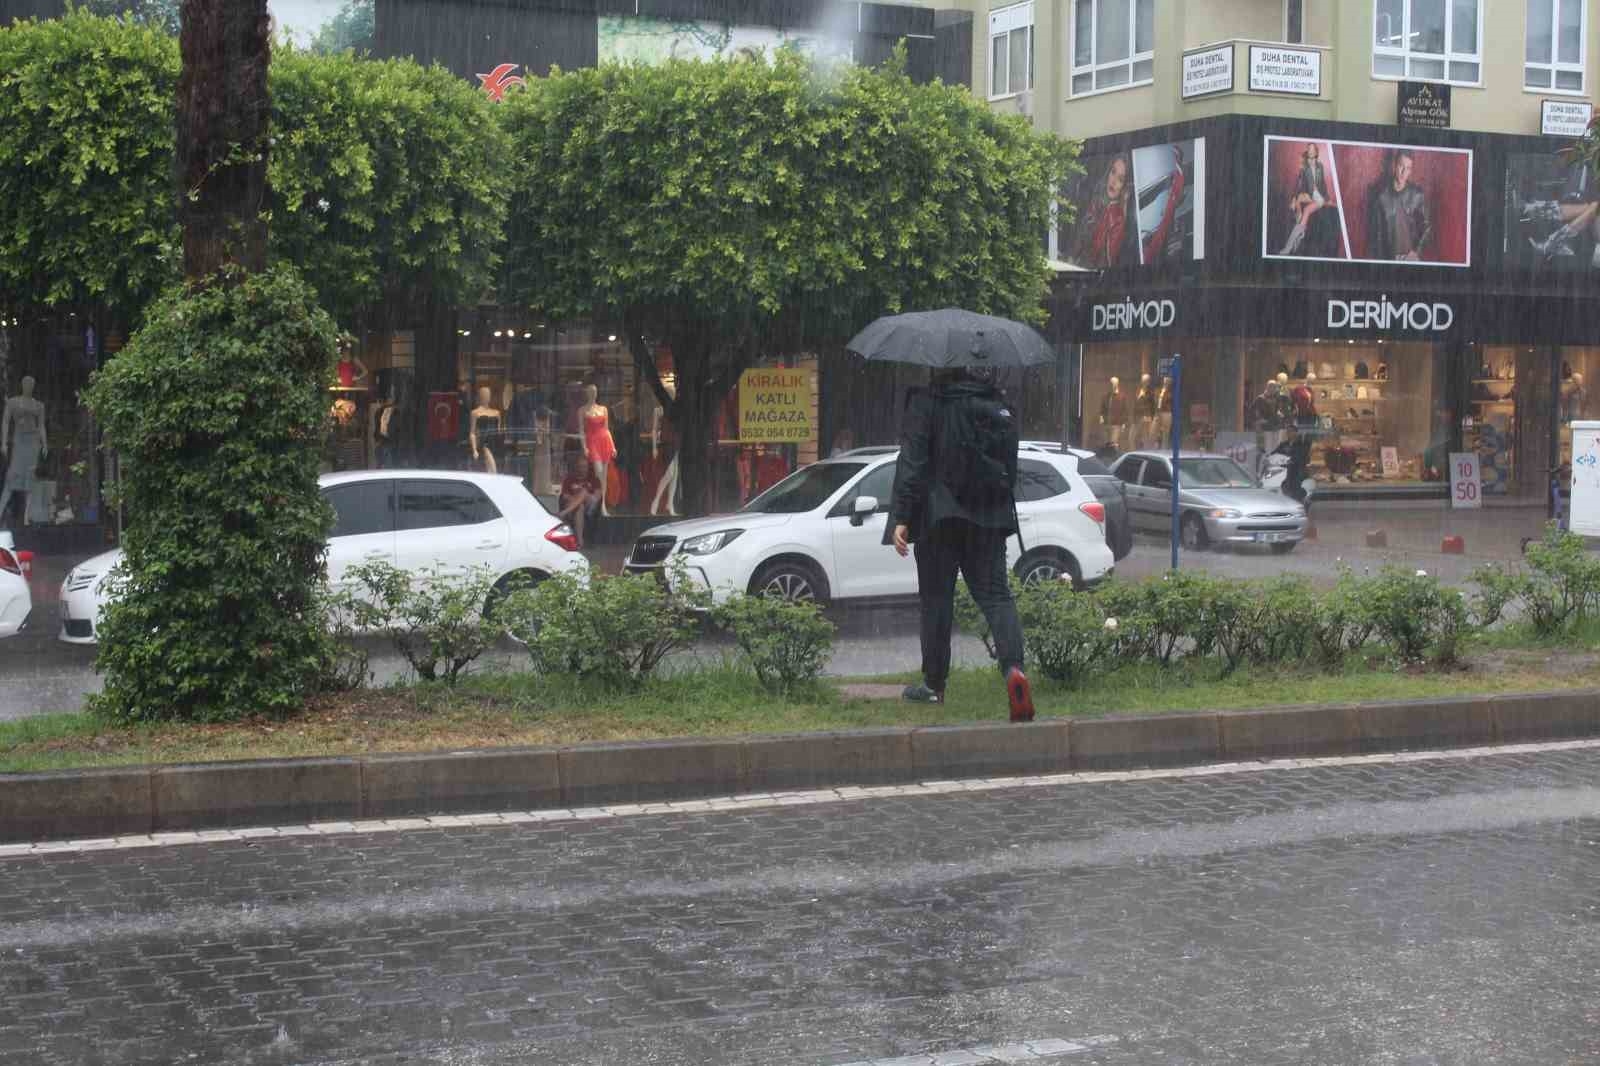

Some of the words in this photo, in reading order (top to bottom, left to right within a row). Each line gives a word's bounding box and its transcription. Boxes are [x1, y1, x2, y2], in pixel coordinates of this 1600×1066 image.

[1262, 51, 1281, 62] DUHA
[1282, 54, 1309, 65] DENTAL
[1092, 295, 1176, 331] DERİMOD
[1327, 294, 1454, 331] DERİMOD
[755, 392, 797, 405] KATLI
[744, 409, 807, 423] MAĞAZA
[1457, 462, 1473, 478] 10
[1456, 482, 1477, 500] 50
